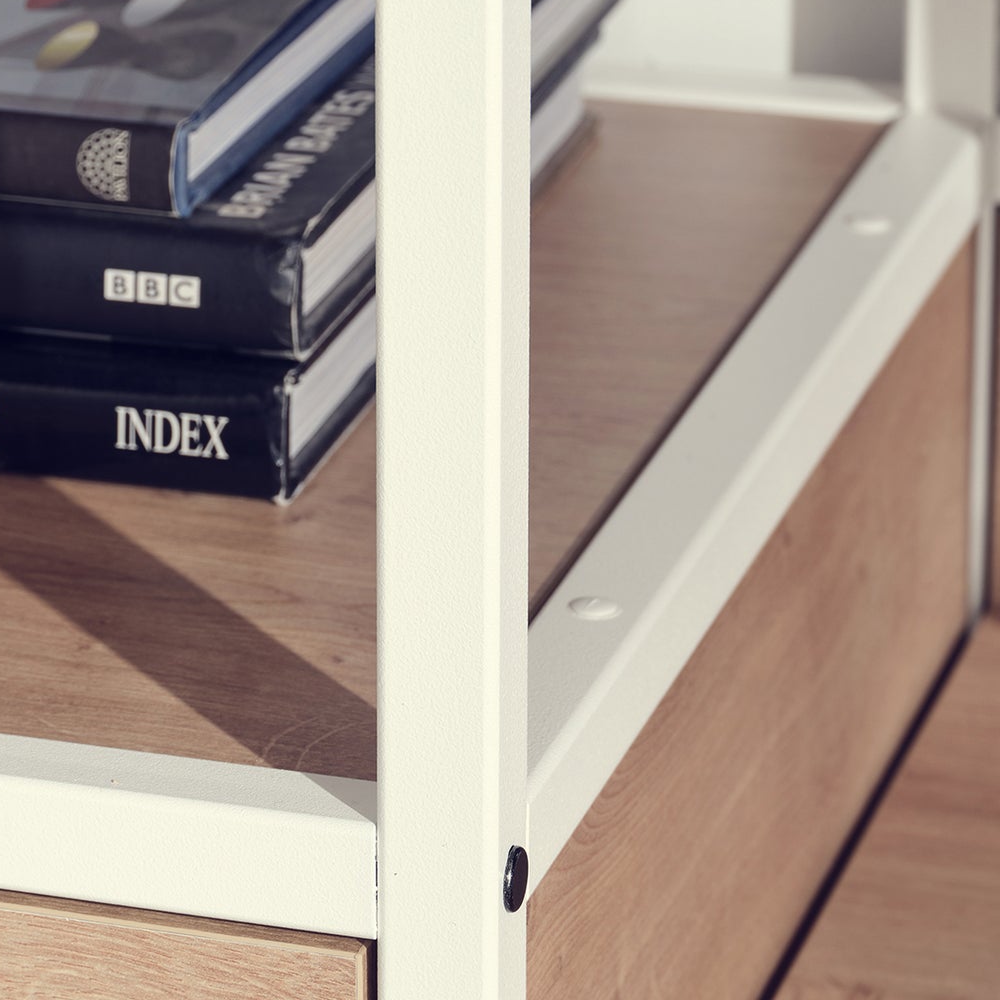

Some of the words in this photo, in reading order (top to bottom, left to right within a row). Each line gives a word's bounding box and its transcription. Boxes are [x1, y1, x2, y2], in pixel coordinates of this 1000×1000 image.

[217, 152, 318, 219] BRIAN
[283, 89, 376, 153] BATES
[107, 270, 198, 306] BBC
[115, 406, 229, 460] INDEX
